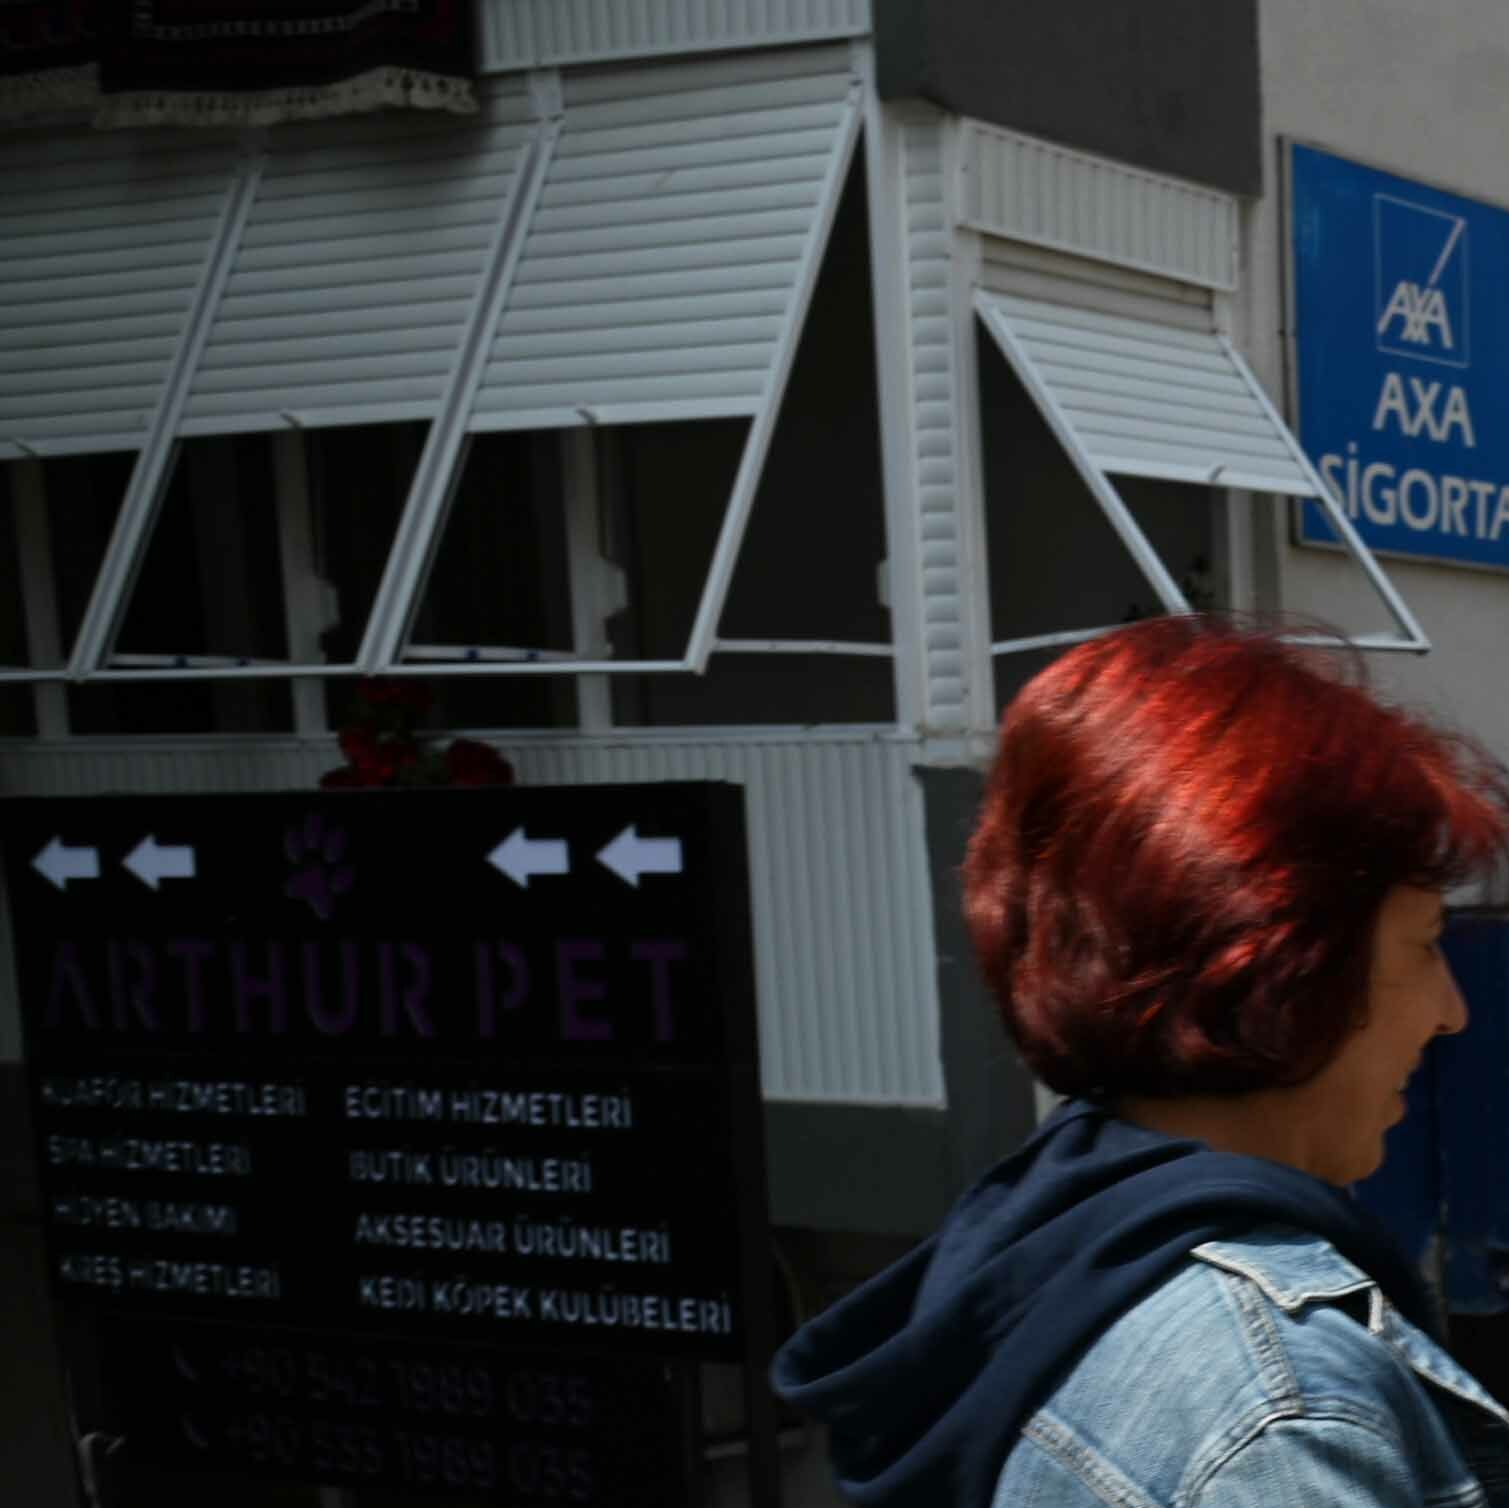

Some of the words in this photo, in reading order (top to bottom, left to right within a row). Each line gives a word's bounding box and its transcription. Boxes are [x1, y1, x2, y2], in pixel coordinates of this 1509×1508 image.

[1377, 280, 1454, 349] AXA
[1373, 372, 1476, 447] AXA
[42, 938, 434, 1038] ARTHUR
[475, 938, 688, 1041] PET
[440, 1144, 592, 1193] ÜRÜNLERİ
[354, 1209, 508, 1253] AKSESUAR
[512, 1210, 672, 1264] ÜRÜNLERİ
[432, 1272, 535, 1320] KÖPEK
[539, 1281, 733, 1334] KULÜBELERİ
